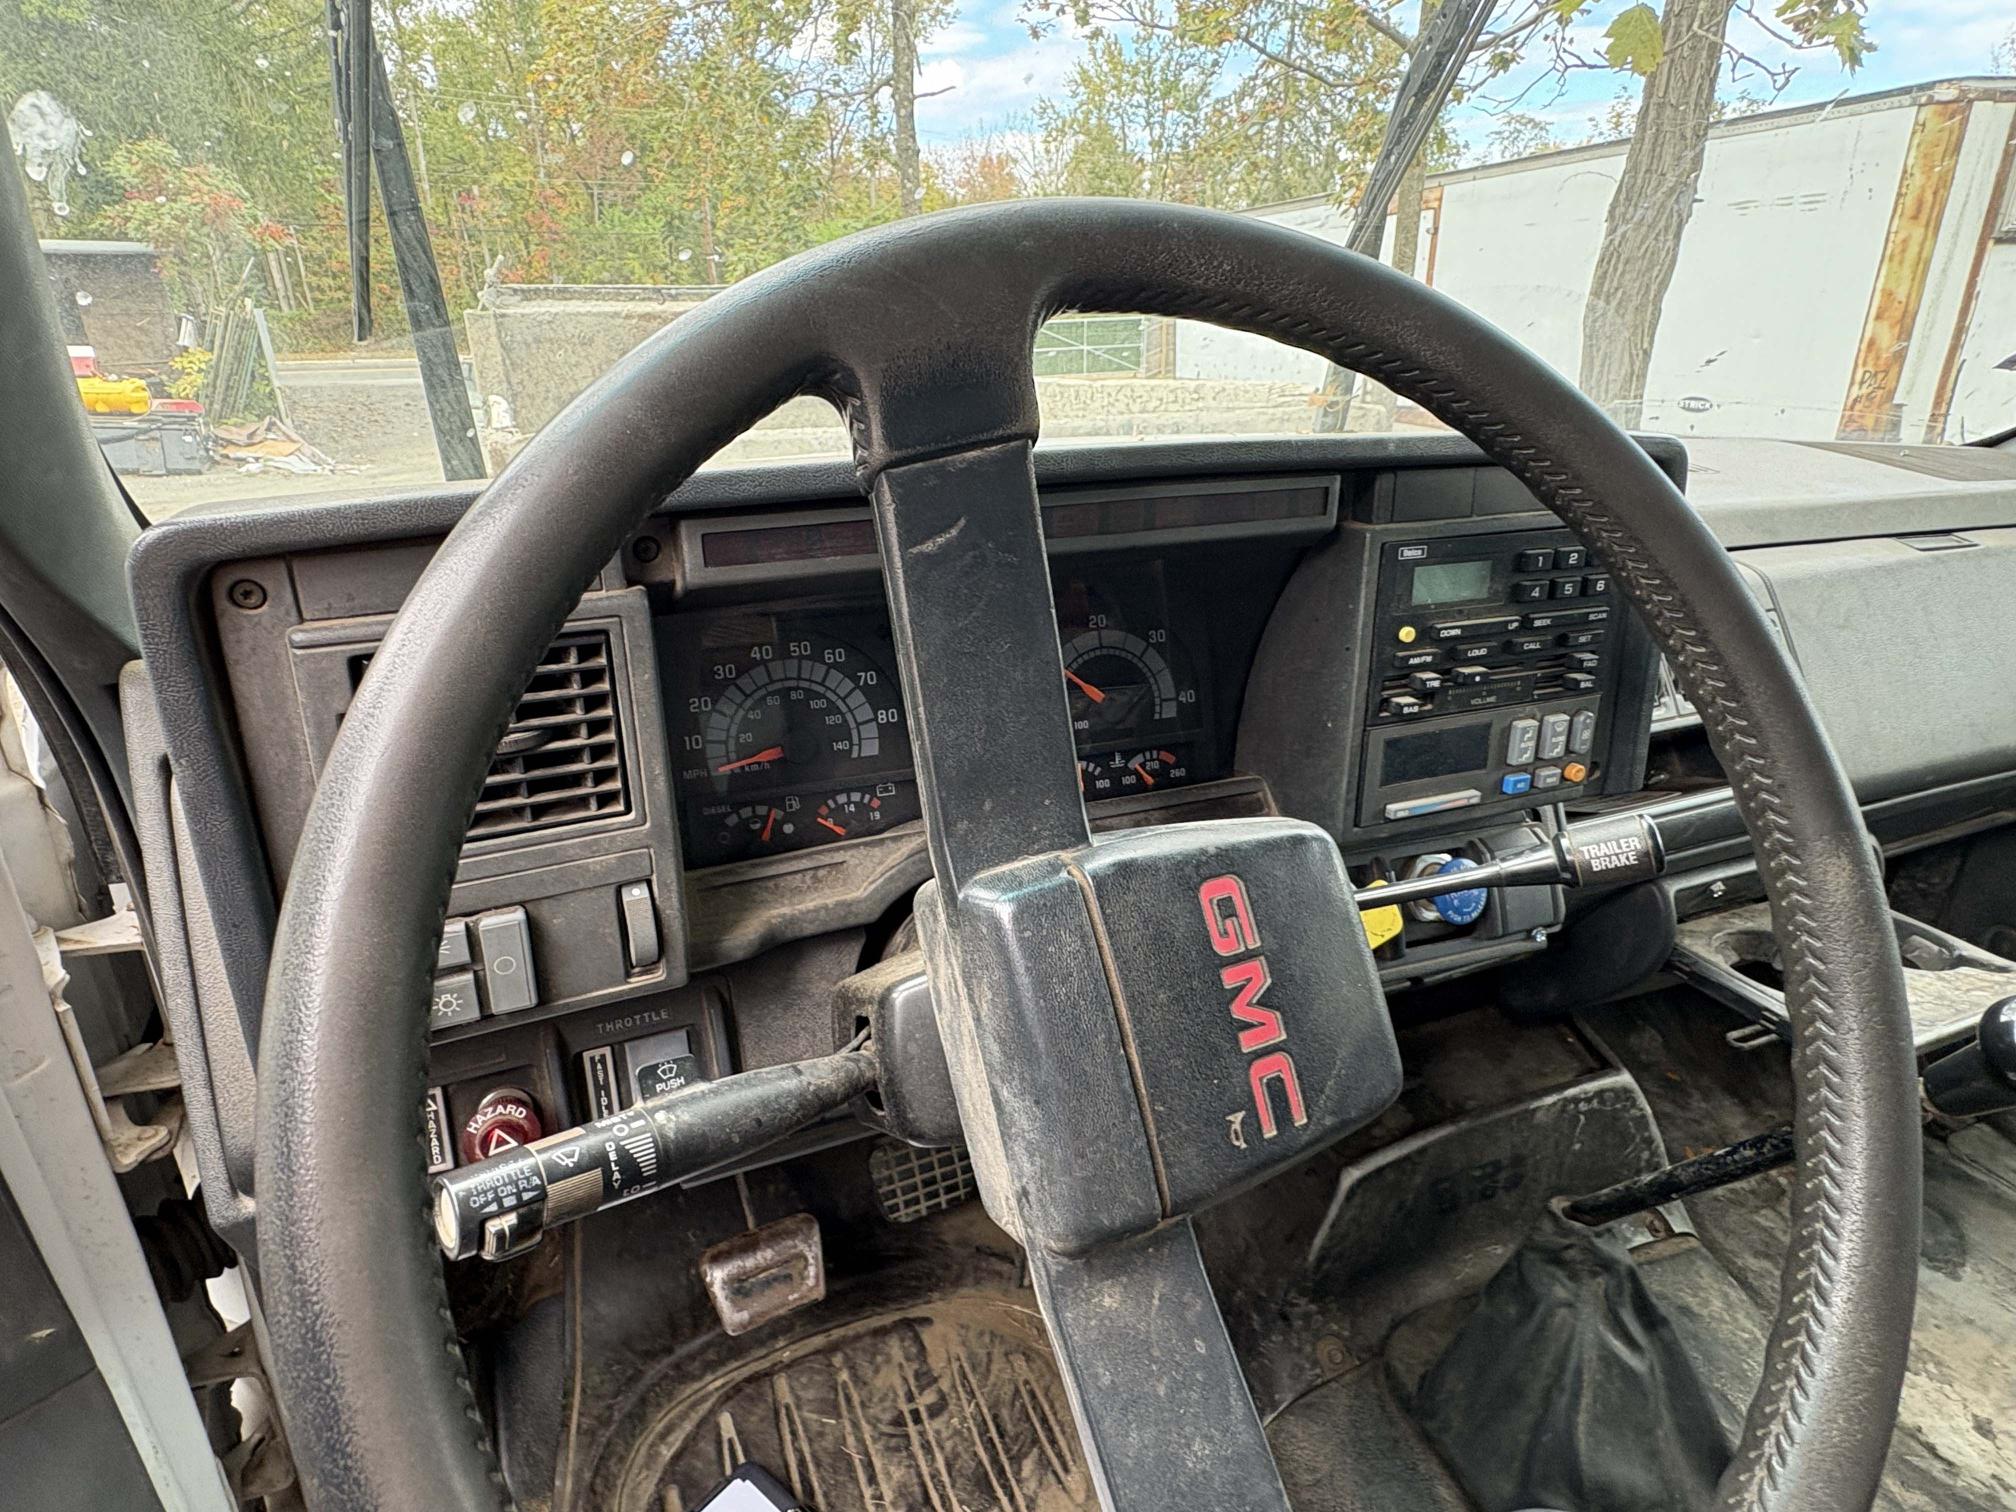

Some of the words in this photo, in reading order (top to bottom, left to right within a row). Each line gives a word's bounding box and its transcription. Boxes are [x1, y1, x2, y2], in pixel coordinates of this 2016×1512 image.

[1679, 400, 1711, 409] STRICK
[1537, 556, 1543, 567] 1
[1568, 553, 1578, 563] 2
[1531, 587, 1540, 597] 4
[1564, 584, 1573, 594] 5
[1596, 580, 1605, 591] 6
[1088, 614, 1107, 628] 20
[1533, 618, 1552, 627] SEEK
[1588, 612, 1607, 620] SCAN
[1149, 629, 1166, 643] 30
[1440, 629, 1461, 637] DOWN
[750, 645, 773, 660] 40
[789, 641, 811, 656] 50
[1467, 648, 1487, 656] LOUD
[1523, 642, 1541, 650] CALL
[824, 648, 845, 663] 60
[713, 664, 736, 679] 30
[857, 671, 877, 686] 70
[1425, 680, 1440, 688] TRE
[689, 696, 712, 712] 20
[809, 698, 827, 709] 100
[1178, 690, 1196, 703] 40
[825, 714, 842, 725] 120
[877, 708, 898, 724] 80
[1074, 720, 1089, 730] 100
[684, 735, 702, 750] 10
[738, 732, 753, 743] 20
[832, 740, 849, 751] 140
[1145, 760, 1160, 770] 210
[683, 770, 708, 780] MPH
[1121, 775, 1136, 785] 100
[1095, 779, 1110, 789] 100
[844, 803, 855, 813] 14
[870, 811, 880, 821] 19
[1580, 837, 1642, 858] TRAILER
[1591, 851, 1638, 872] BRAKE
[1198, 874, 1308, 1140] GMC
[596, 1008, 669, 1034] THROTTLE
[594, 1055, 604, 1086] FAST
[655, 1076, 685, 1093] PUSH
[466, 1104, 527, 1135] HAZARD
[427, 1111, 442, 1165] HAZARD
[605, 1141, 621, 1190] DELAY
[470, 1166, 533, 1195] THROTTLE
[469, 1190, 496, 1208] OFF
[497, 1184, 517, 1197] ON
